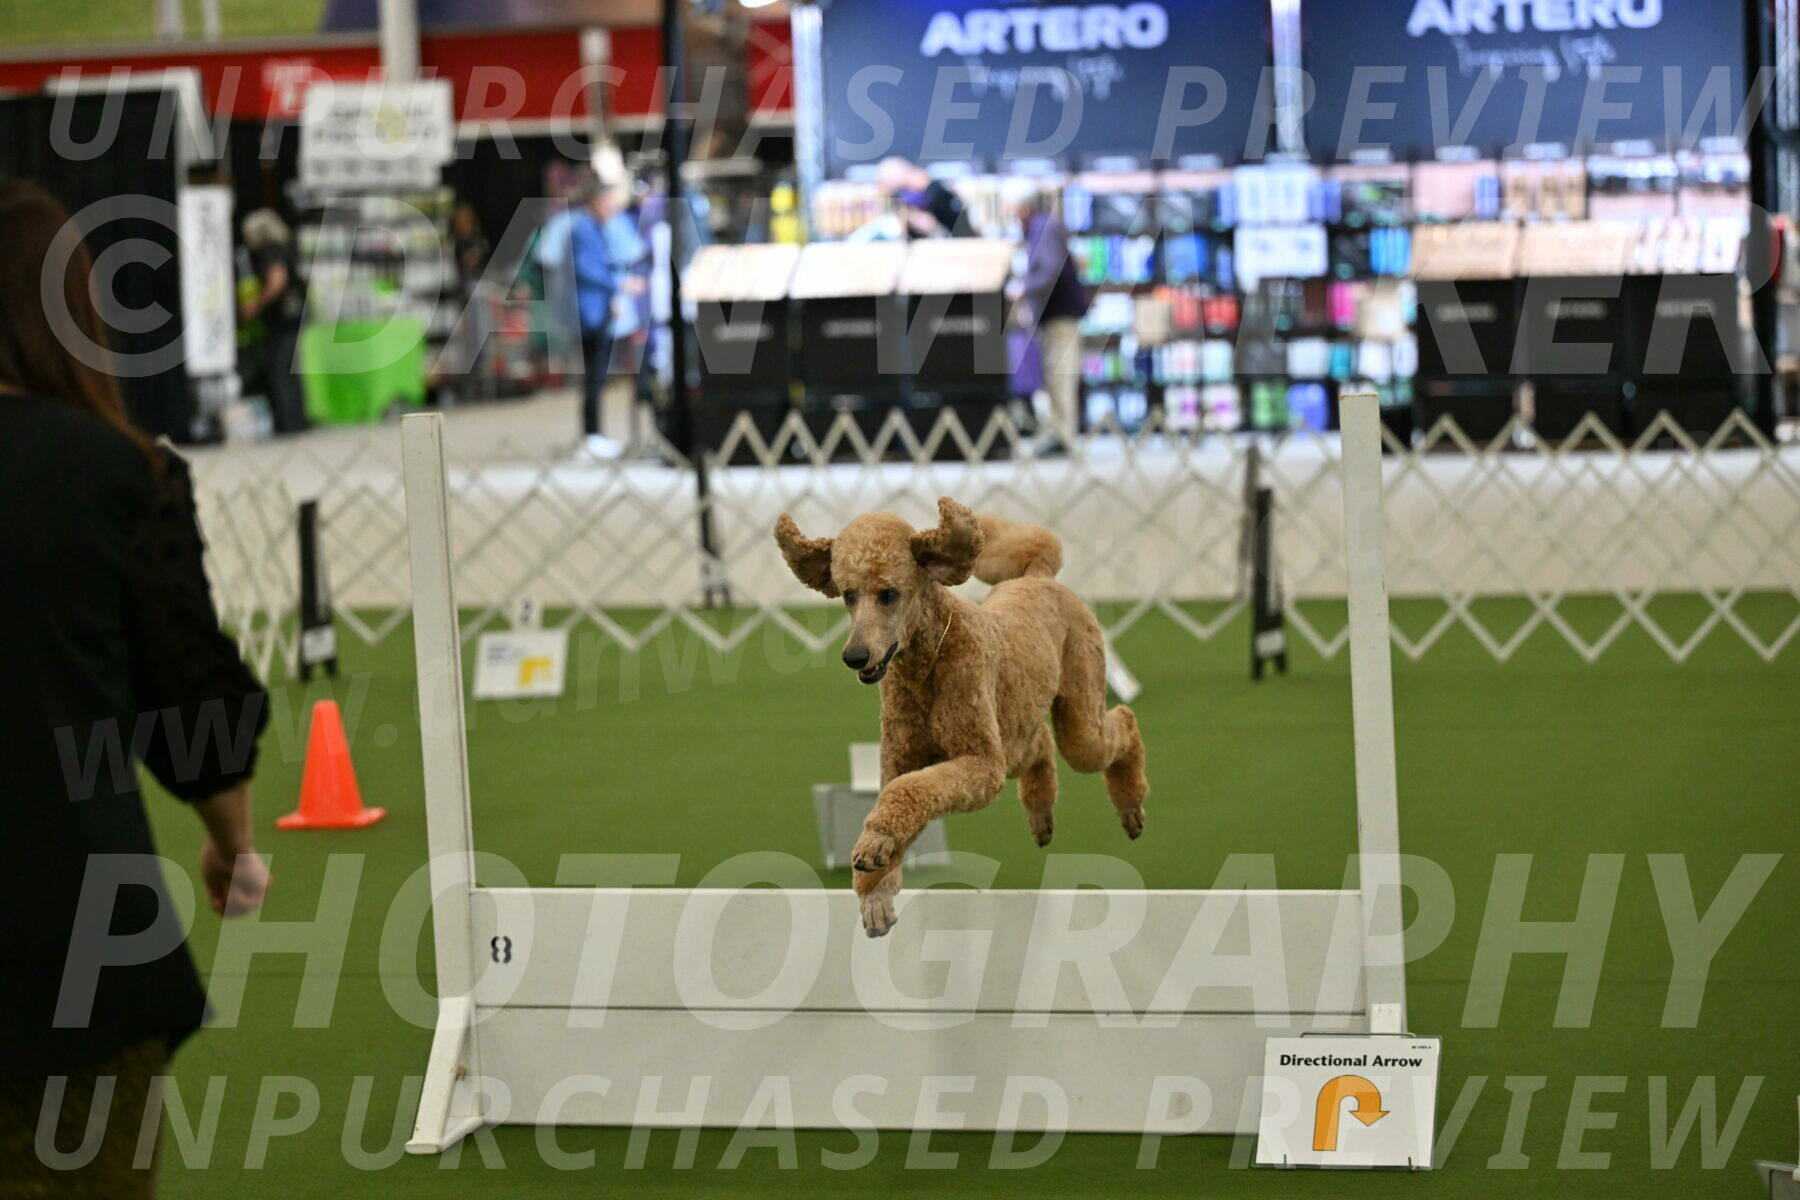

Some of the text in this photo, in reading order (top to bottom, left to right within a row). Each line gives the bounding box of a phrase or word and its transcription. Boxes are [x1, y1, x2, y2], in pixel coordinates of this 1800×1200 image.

[920, 3, 1169, 56] ARTERO
[1406, 0, 1662, 36] ARTERO
[491, 936, 512, 963] 8
[1280, 1055, 1422, 1067] Directional Arrow
